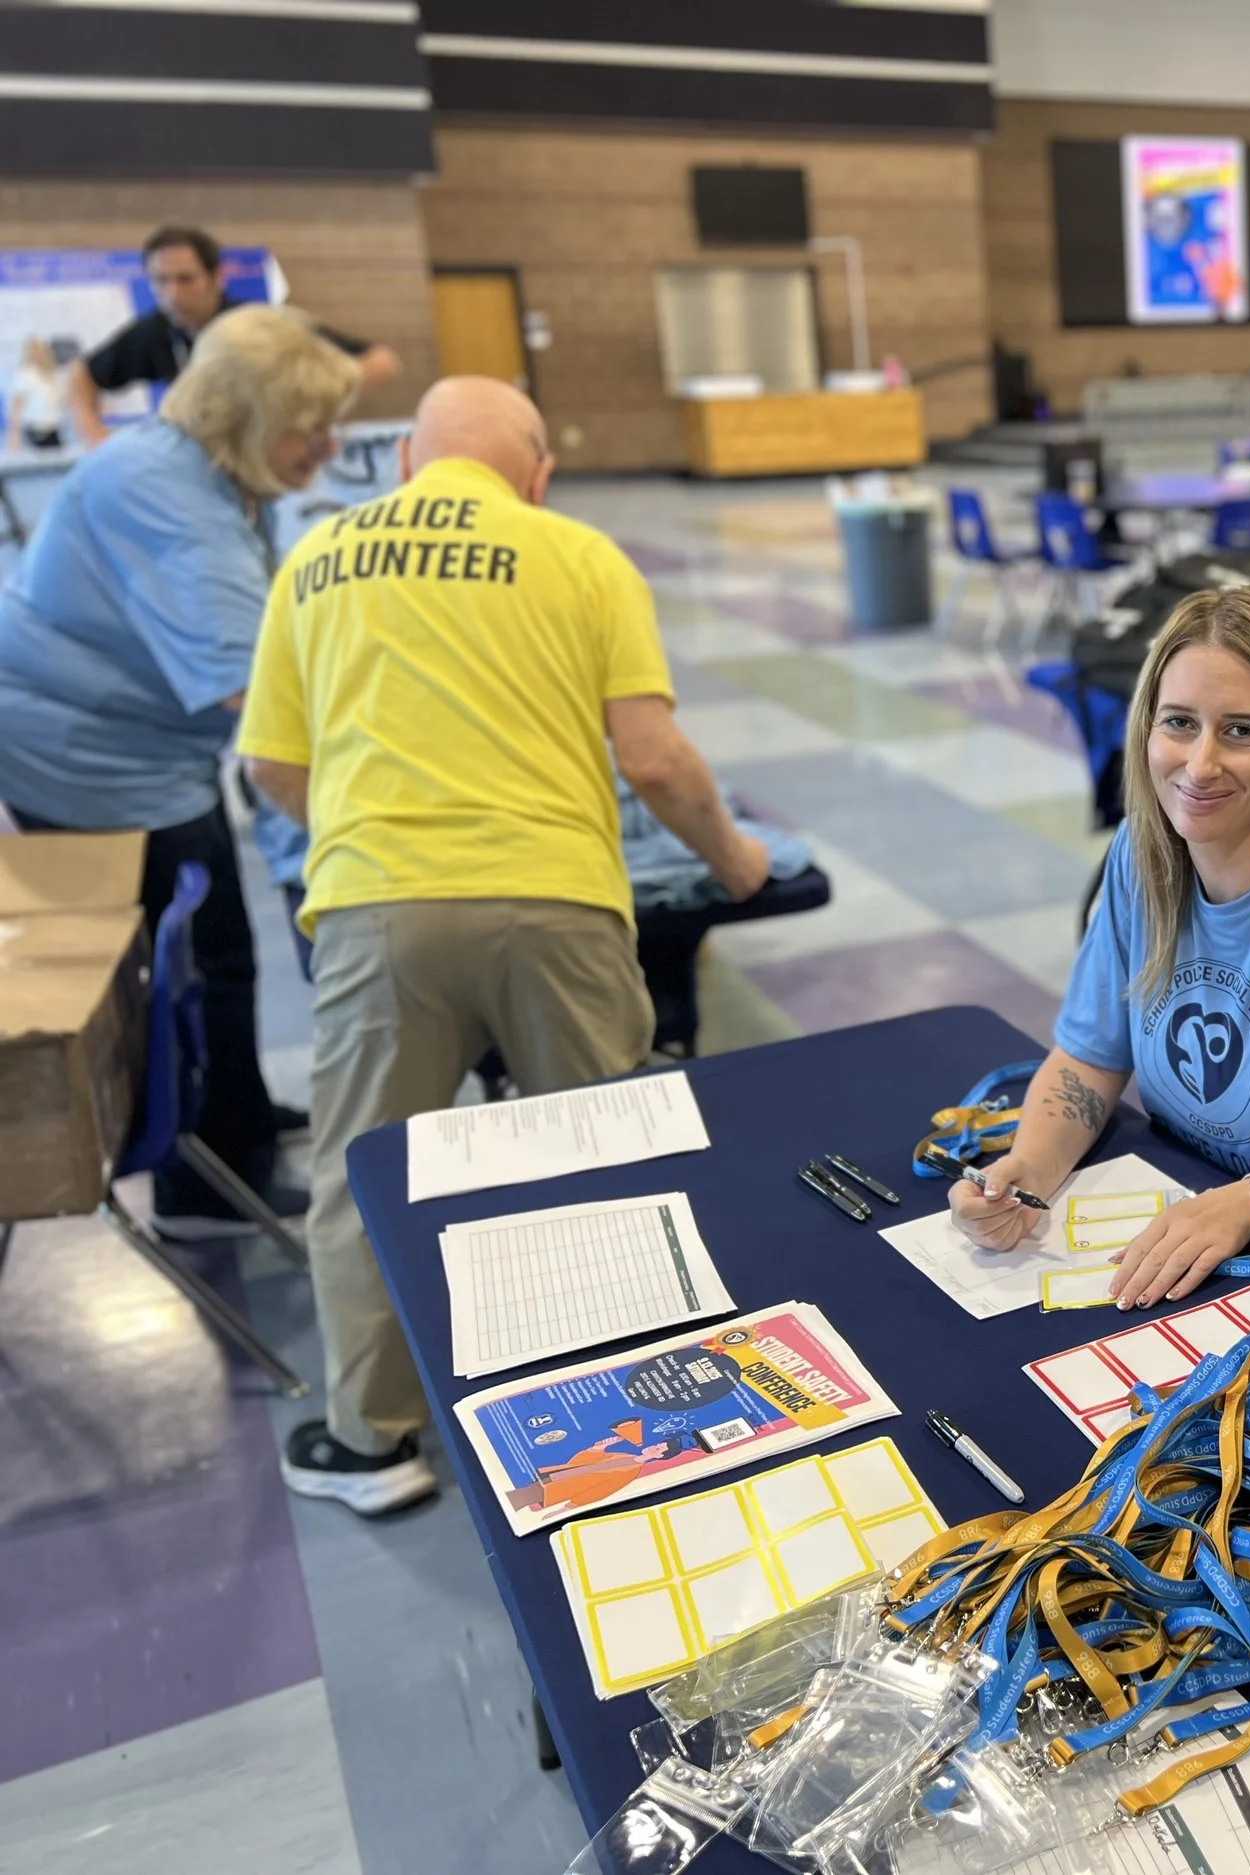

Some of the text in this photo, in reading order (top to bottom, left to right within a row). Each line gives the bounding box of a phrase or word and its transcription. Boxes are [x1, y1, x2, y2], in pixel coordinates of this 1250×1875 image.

[331, 496, 482, 539] POLICE
[294, 539, 518, 605] VOLUNTEER
[1188, 1112, 1235, 1139] CCSDPD
[739, 1361, 816, 1413] CONFERENCE
[747, 1335, 815, 1376] STUDENT
[791, 1369, 852, 1406] SAFETY
[1206, 1343, 1250, 1394] CCSDPD Student
[1139, 1408, 1170, 1449] Conference
[1110, 1465, 1134, 1504] CCSDPD
[1144, 1574, 1203, 1594] Conference
[1206, 1565, 1240, 1607] CCSDPD
[1040, 1589, 1059, 1620] 988
[1073, 1650, 1100, 1680] 988
[1177, 1673, 1221, 1694] CCSDPD
[986, 1642, 1037, 1729] Student Safety
[1102, 1702, 1145, 1735] CCSDPD
[1173, 1757, 1203, 1777] 988
